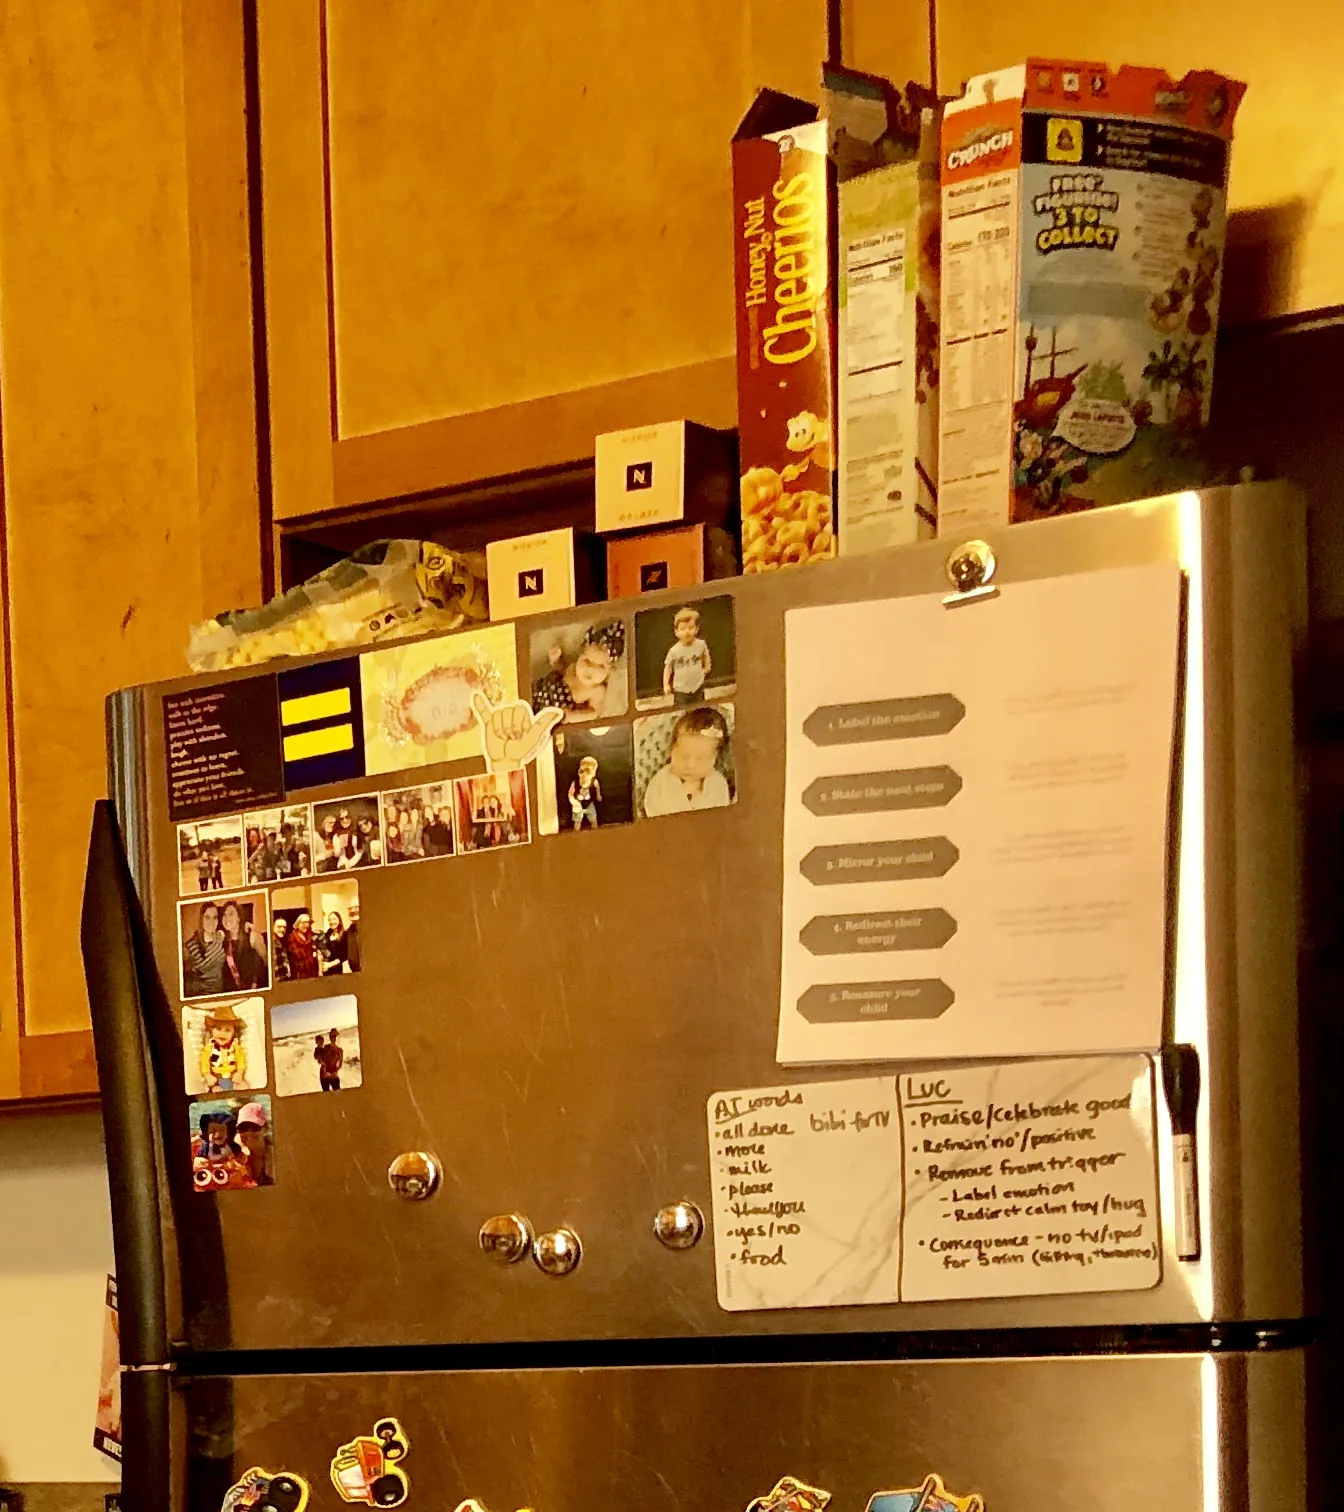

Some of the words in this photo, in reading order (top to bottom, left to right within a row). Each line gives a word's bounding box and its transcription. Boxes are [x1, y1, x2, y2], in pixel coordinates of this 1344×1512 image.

[743, 196, 765, 239] Nut
[745, 232, 773, 308] Honey
[763, 173, 817, 364] Cheerios
[722, 1122, 744, 1140] all
[748, 1121, 795, 1137] done
[725, 1143, 766, 1157] more
[728, 1160, 772, 1176] milk
[729, 1181, 774, 1200] please
[953, 1185, 997, 1202] Label
[1003, 1181, 1075, 1199] emotion
[740, 1245, 787, 1266] food
[943, 1255, 971, 1270] for
